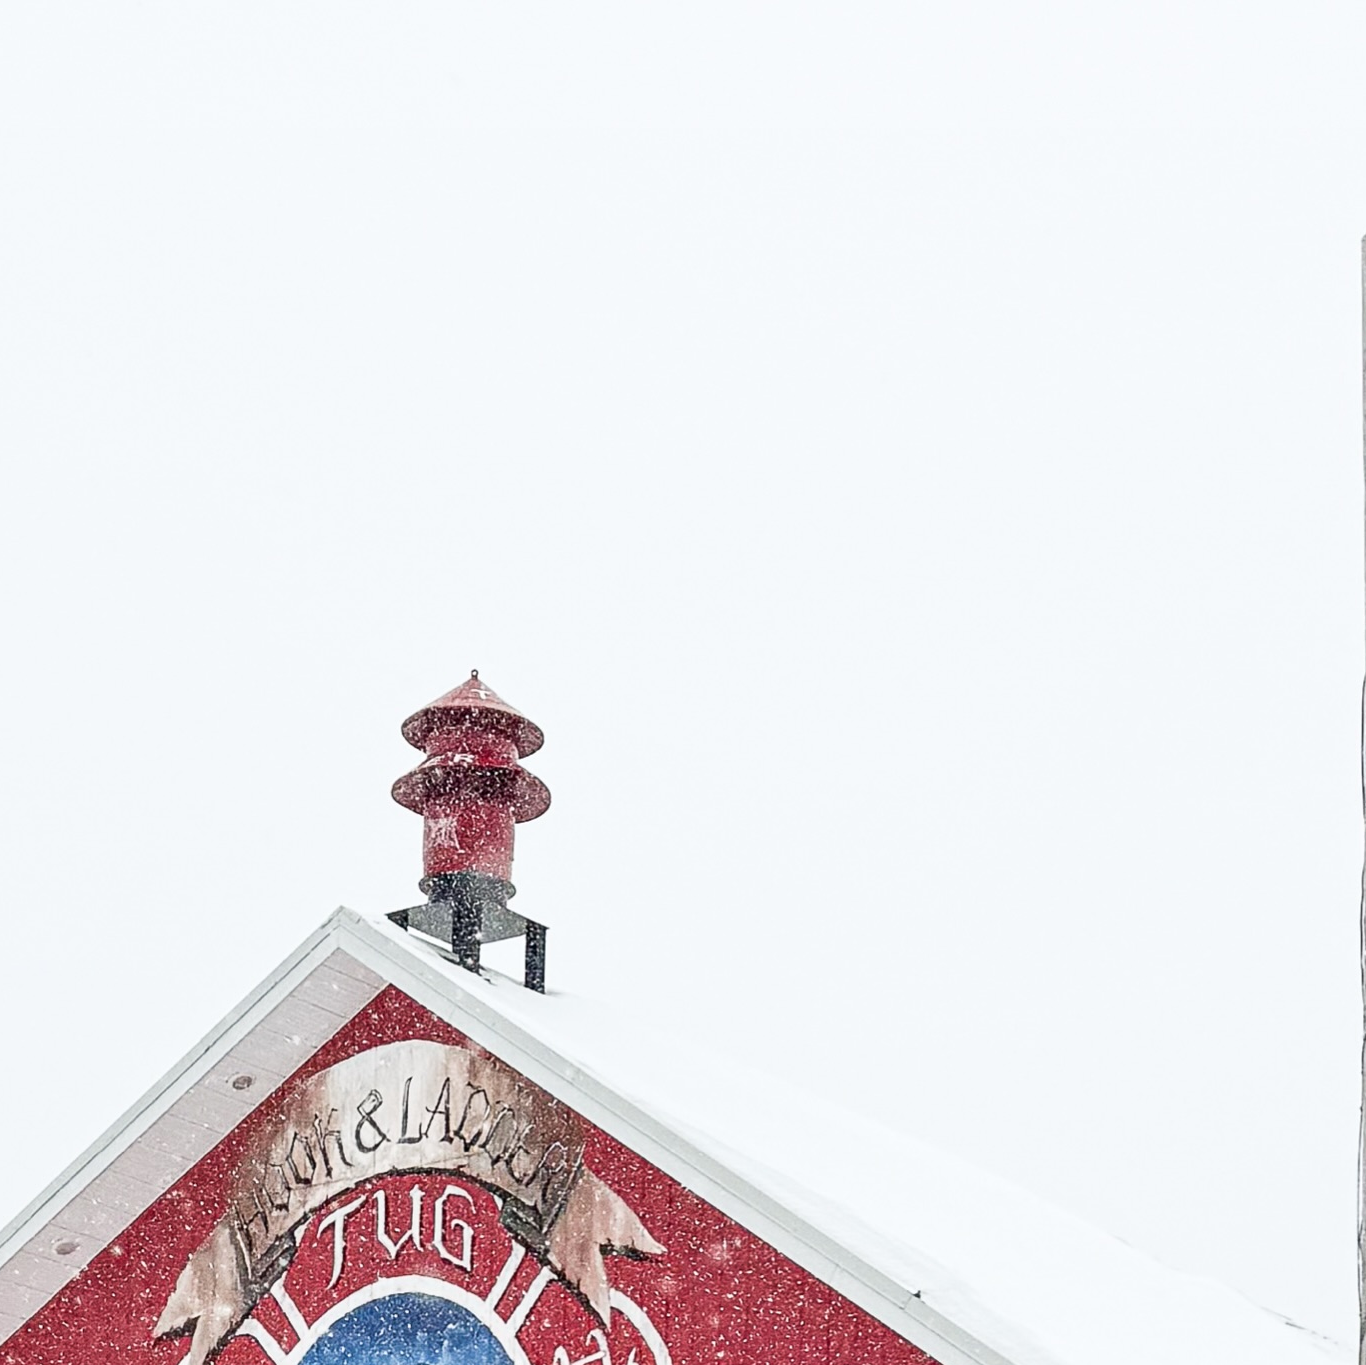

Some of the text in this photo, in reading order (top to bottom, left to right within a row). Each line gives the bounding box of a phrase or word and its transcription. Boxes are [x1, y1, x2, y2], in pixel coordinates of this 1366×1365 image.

[234, 1076, 586, 1278] HOOK & LADDER
[316, 1184, 477, 1290] TUG
